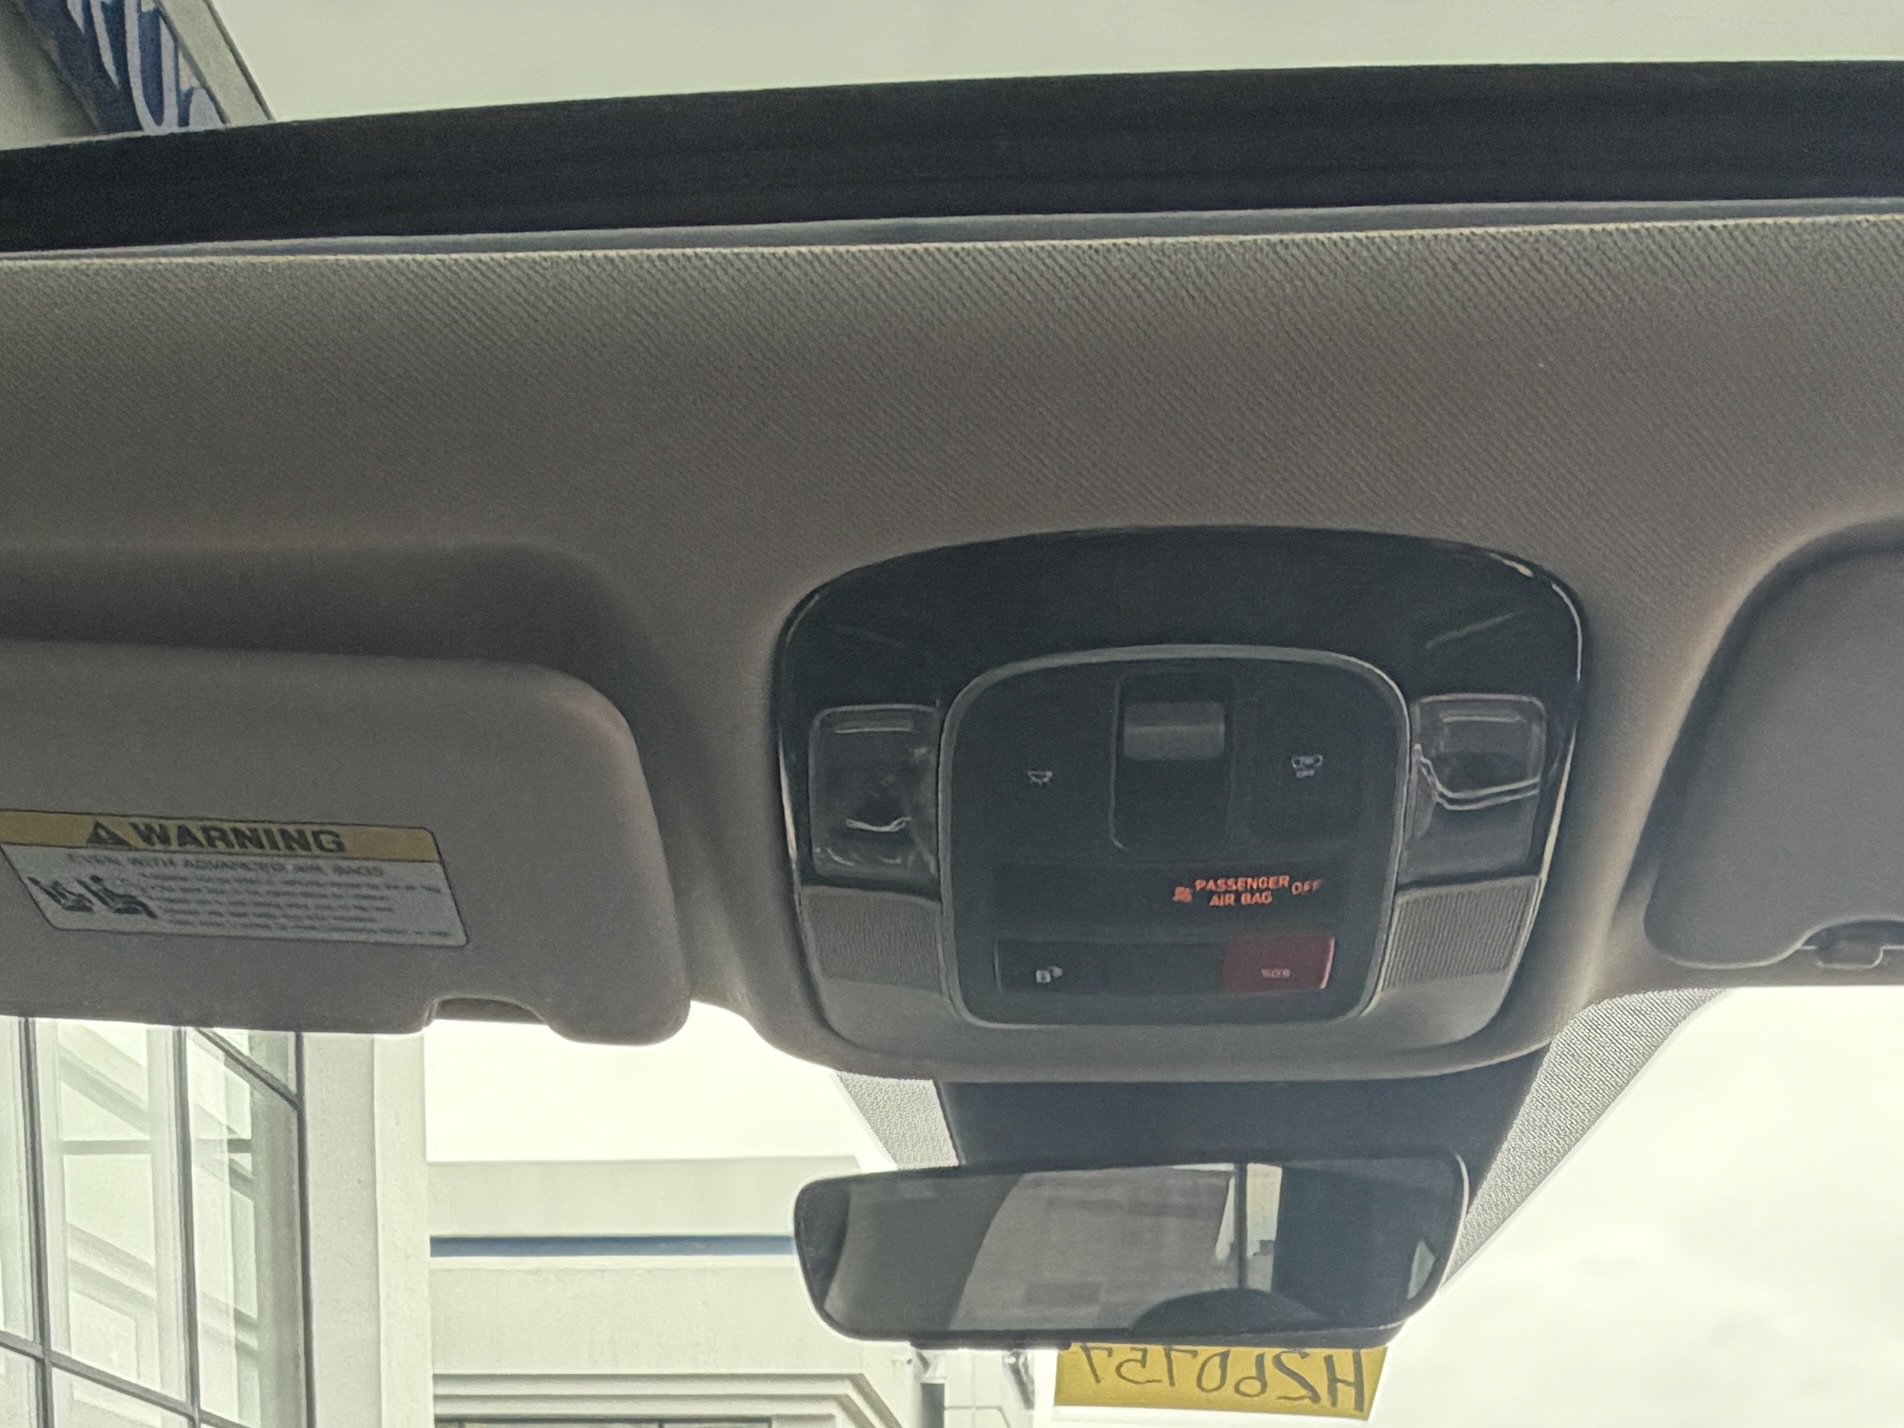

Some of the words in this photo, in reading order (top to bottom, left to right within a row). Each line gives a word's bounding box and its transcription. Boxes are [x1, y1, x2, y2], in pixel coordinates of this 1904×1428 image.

[130, 820, 346, 854] WARNING
[130, 857, 176, 869] WITH
[183, 859, 286, 874] ADVANCED
[1194, 875, 1290, 891] PASSENGER
[1291, 880, 1322, 896] OFF
[1209, 893, 1235, 907] AIR
[1240, 891, 1273, 905] BAG
